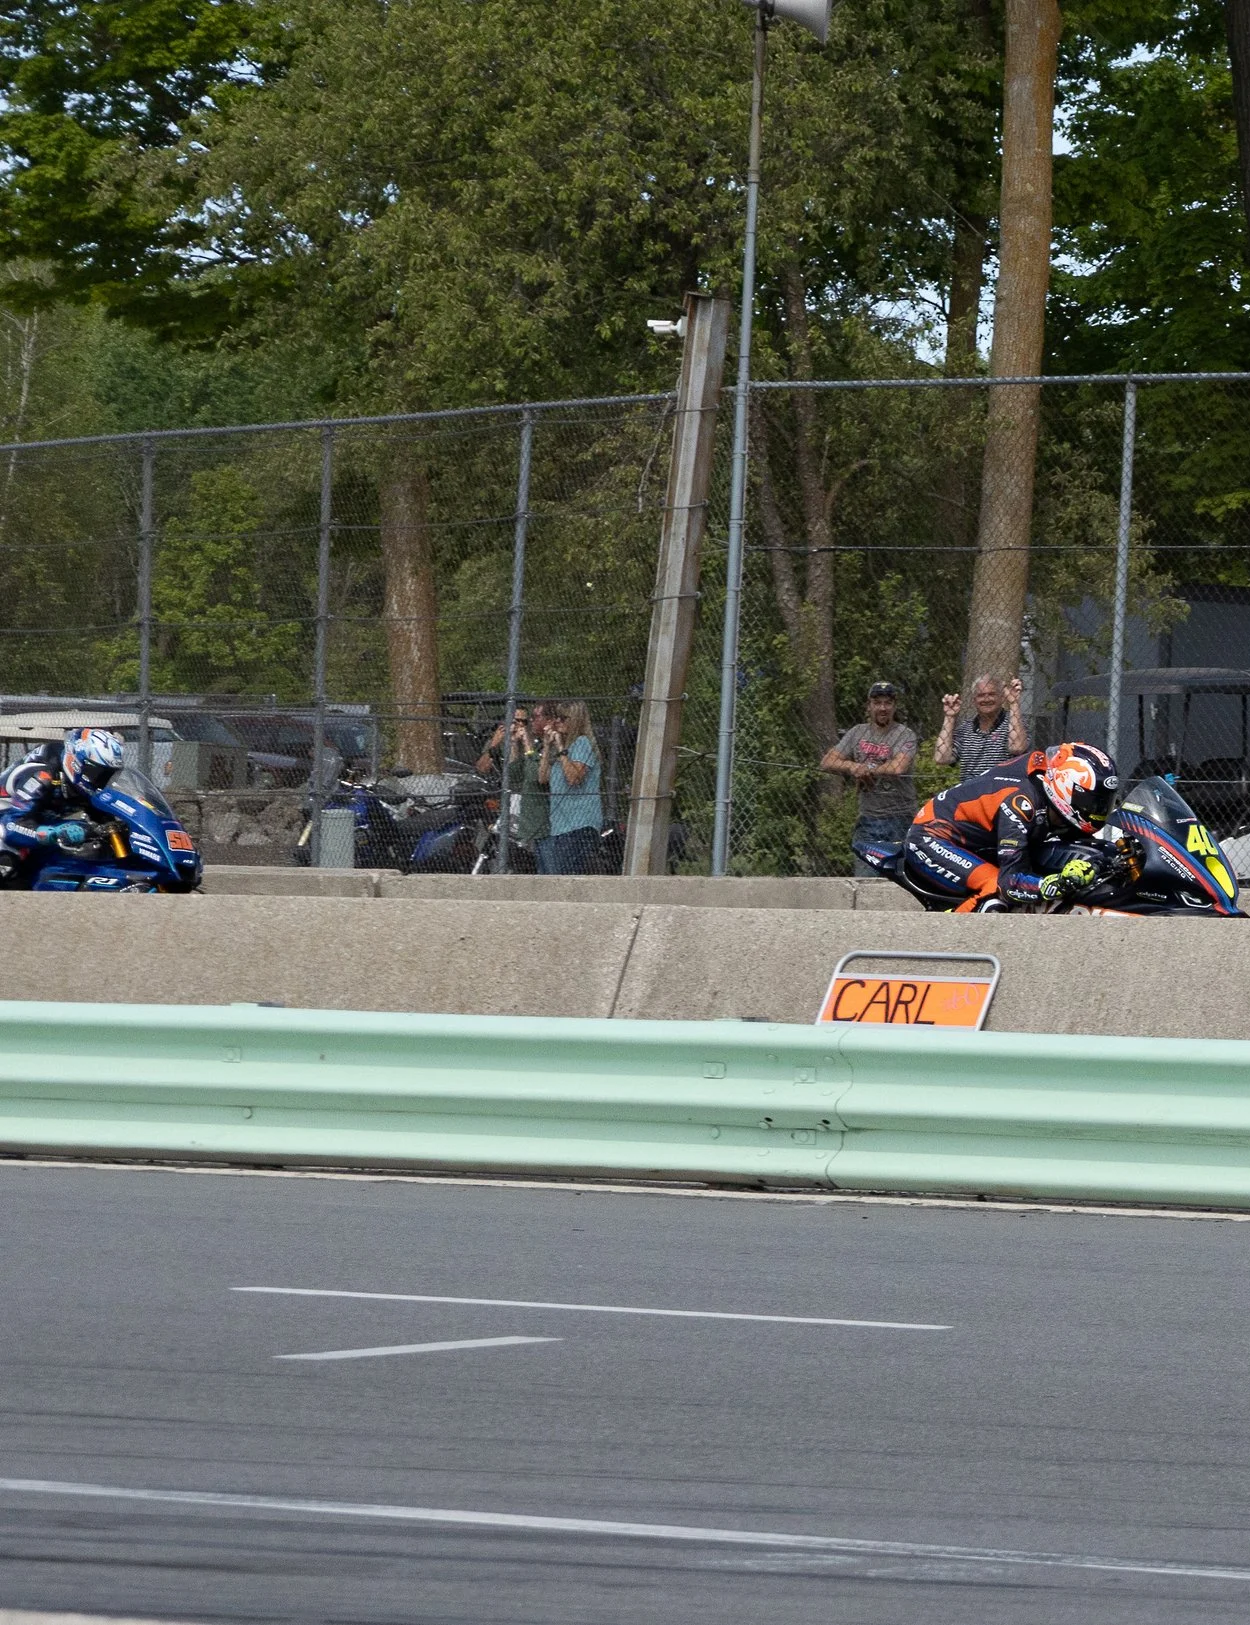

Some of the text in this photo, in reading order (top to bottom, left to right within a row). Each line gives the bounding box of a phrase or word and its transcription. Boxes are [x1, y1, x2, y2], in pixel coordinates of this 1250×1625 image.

[929, 840, 973, 869] MOTORRAD
[1161, 854, 1187, 879] RACING
[832, 980, 935, 1025] CARL
